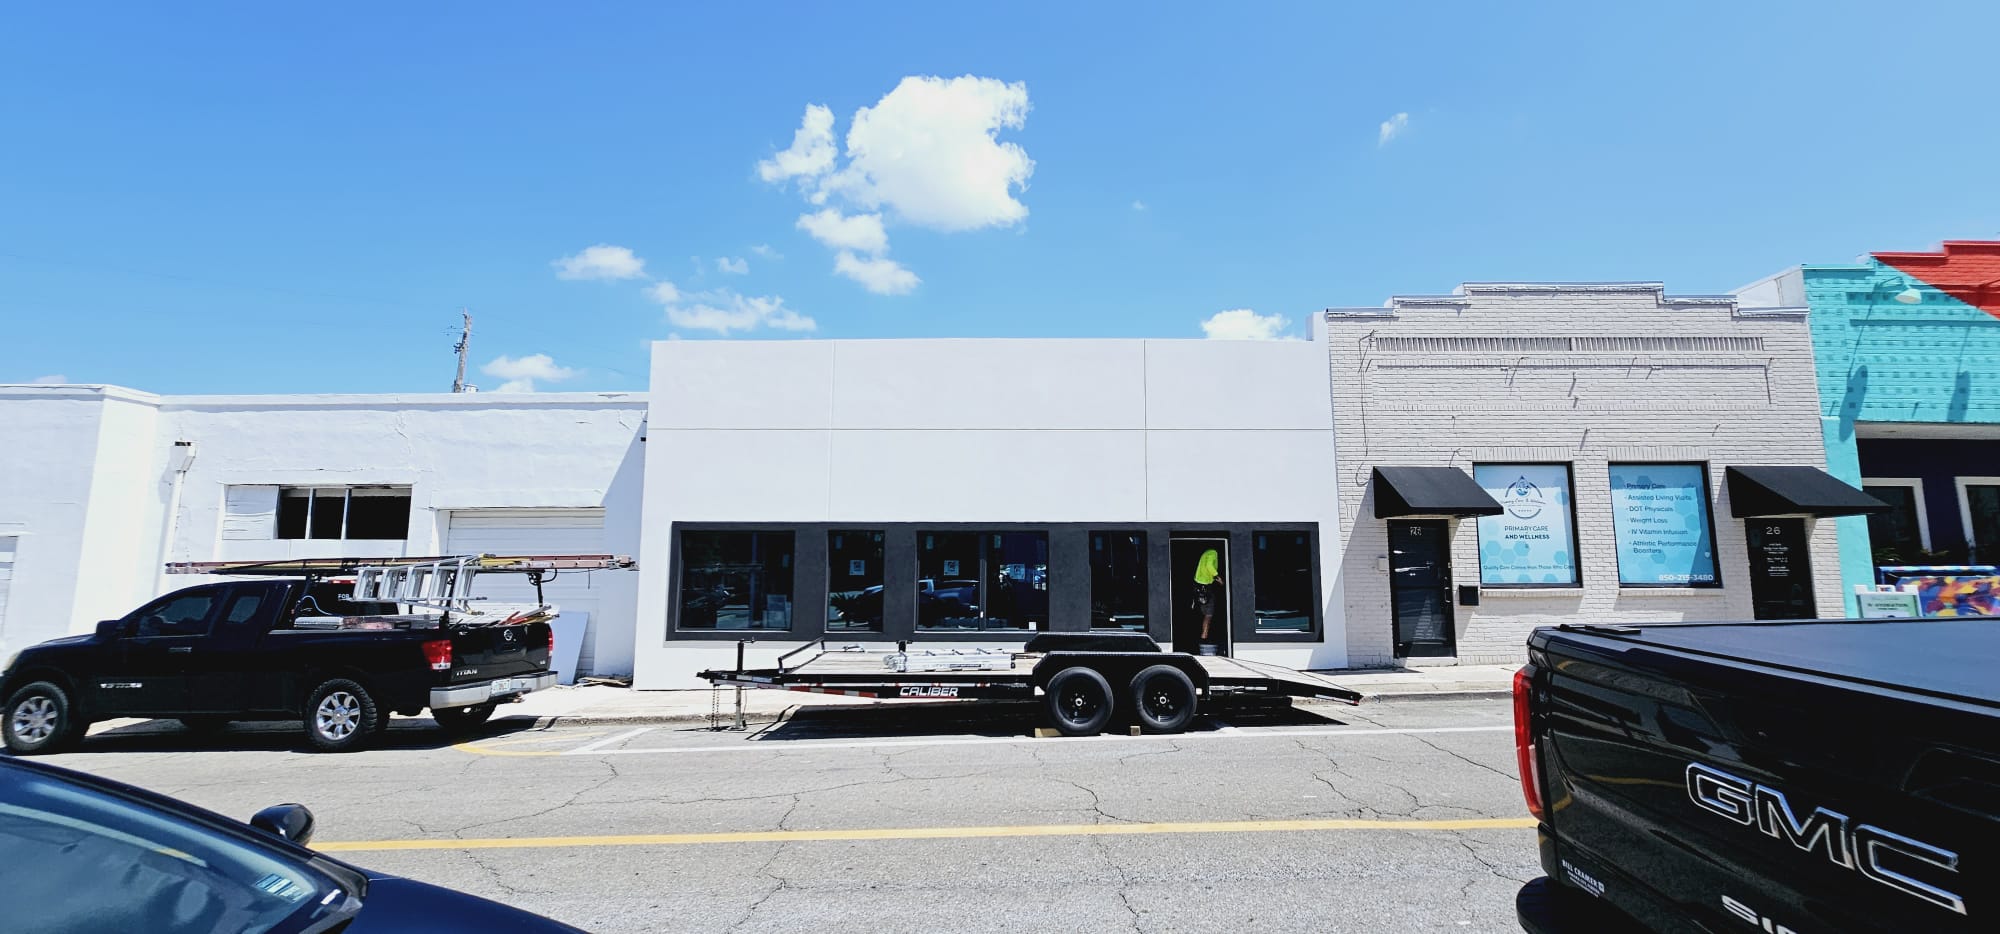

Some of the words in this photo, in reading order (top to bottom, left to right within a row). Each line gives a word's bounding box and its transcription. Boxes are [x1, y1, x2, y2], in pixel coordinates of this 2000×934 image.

[1766, 526, 1781, 535] 26
[900, 686, 958, 697] CALIBER
[1685, 761, 1968, 916] GMC
[1562, 858, 1574, 872] BILL
[1574, 867, 1598, 888] CRAMER
